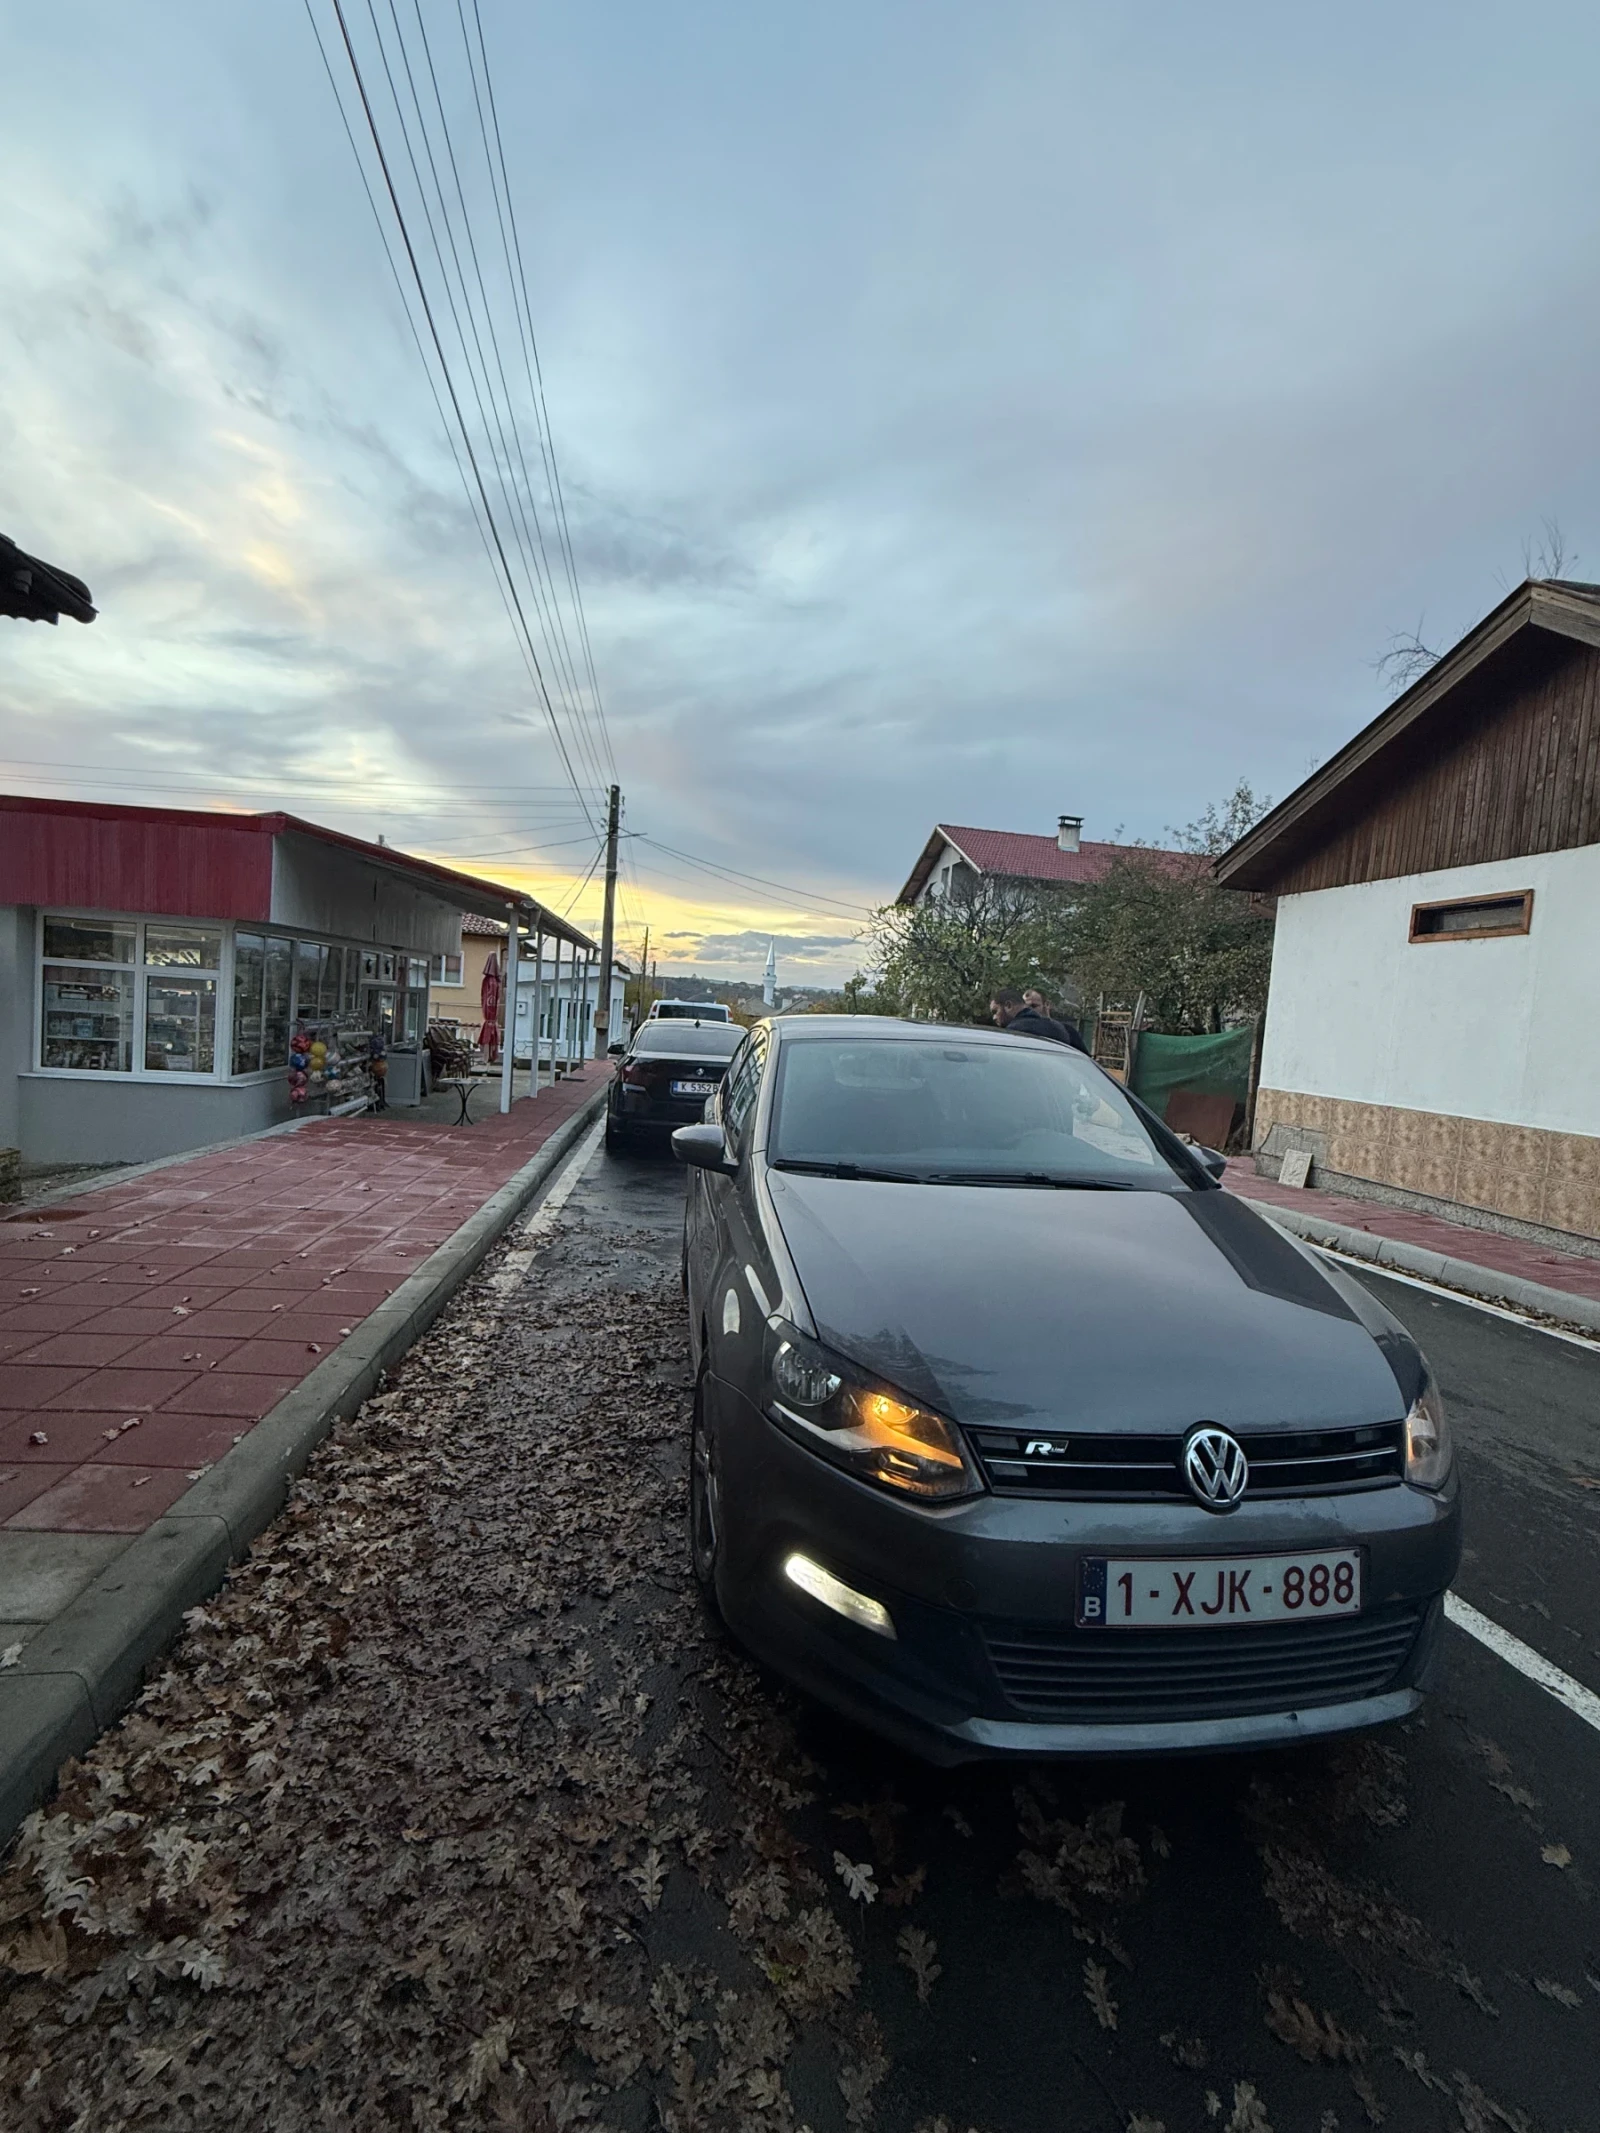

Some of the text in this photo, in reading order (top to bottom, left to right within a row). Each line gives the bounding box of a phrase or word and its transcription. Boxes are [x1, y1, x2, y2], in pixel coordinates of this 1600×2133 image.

[681, 1083, 687, 1091] K
[1025, 1441, 1052, 1455] R
[1084, 1596, 1101, 1617] B
